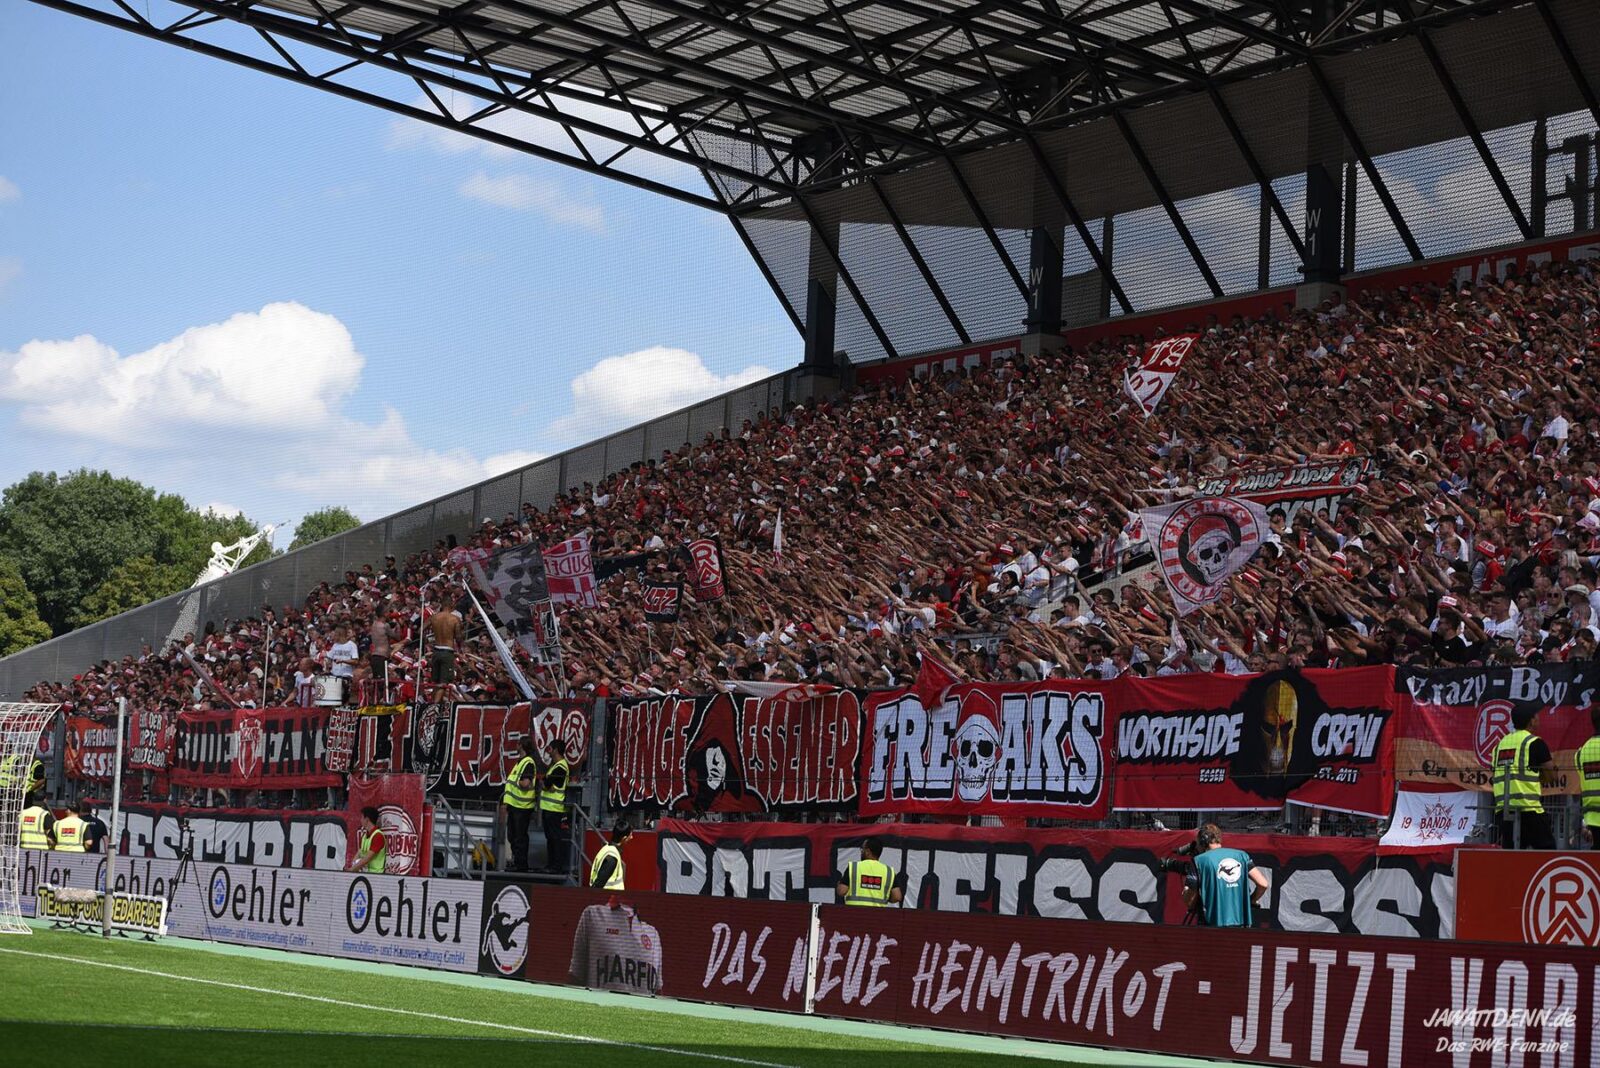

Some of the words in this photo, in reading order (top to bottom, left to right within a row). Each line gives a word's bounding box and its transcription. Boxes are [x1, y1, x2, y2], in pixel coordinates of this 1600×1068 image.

[1306, 208, 1321, 229] W
[1030, 266, 1044, 286] W
[176, 719, 234, 774] RUDE
[609, 696, 696, 807] JUNGE
[743, 690, 861, 805] ESSENER
[869, 690, 1105, 807] FREAKS
[1118, 712, 1244, 759] NORTHSIDE
[1311, 713, 1384, 757] CREW
[1401, 817, 1412, 829] 19
[1420, 817, 1452, 830] BANDA
[1458, 817, 1469, 830] 07
[208, 865, 311, 927] Oehler
[346, 875, 468, 943] Oehler
[702, 922, 773, 994] DAS
[782, 927, 898, 1007] NEUE
[1229, 945, 1416, 1068] JETZT
[1450, 956, 1600, 1068] VOR
